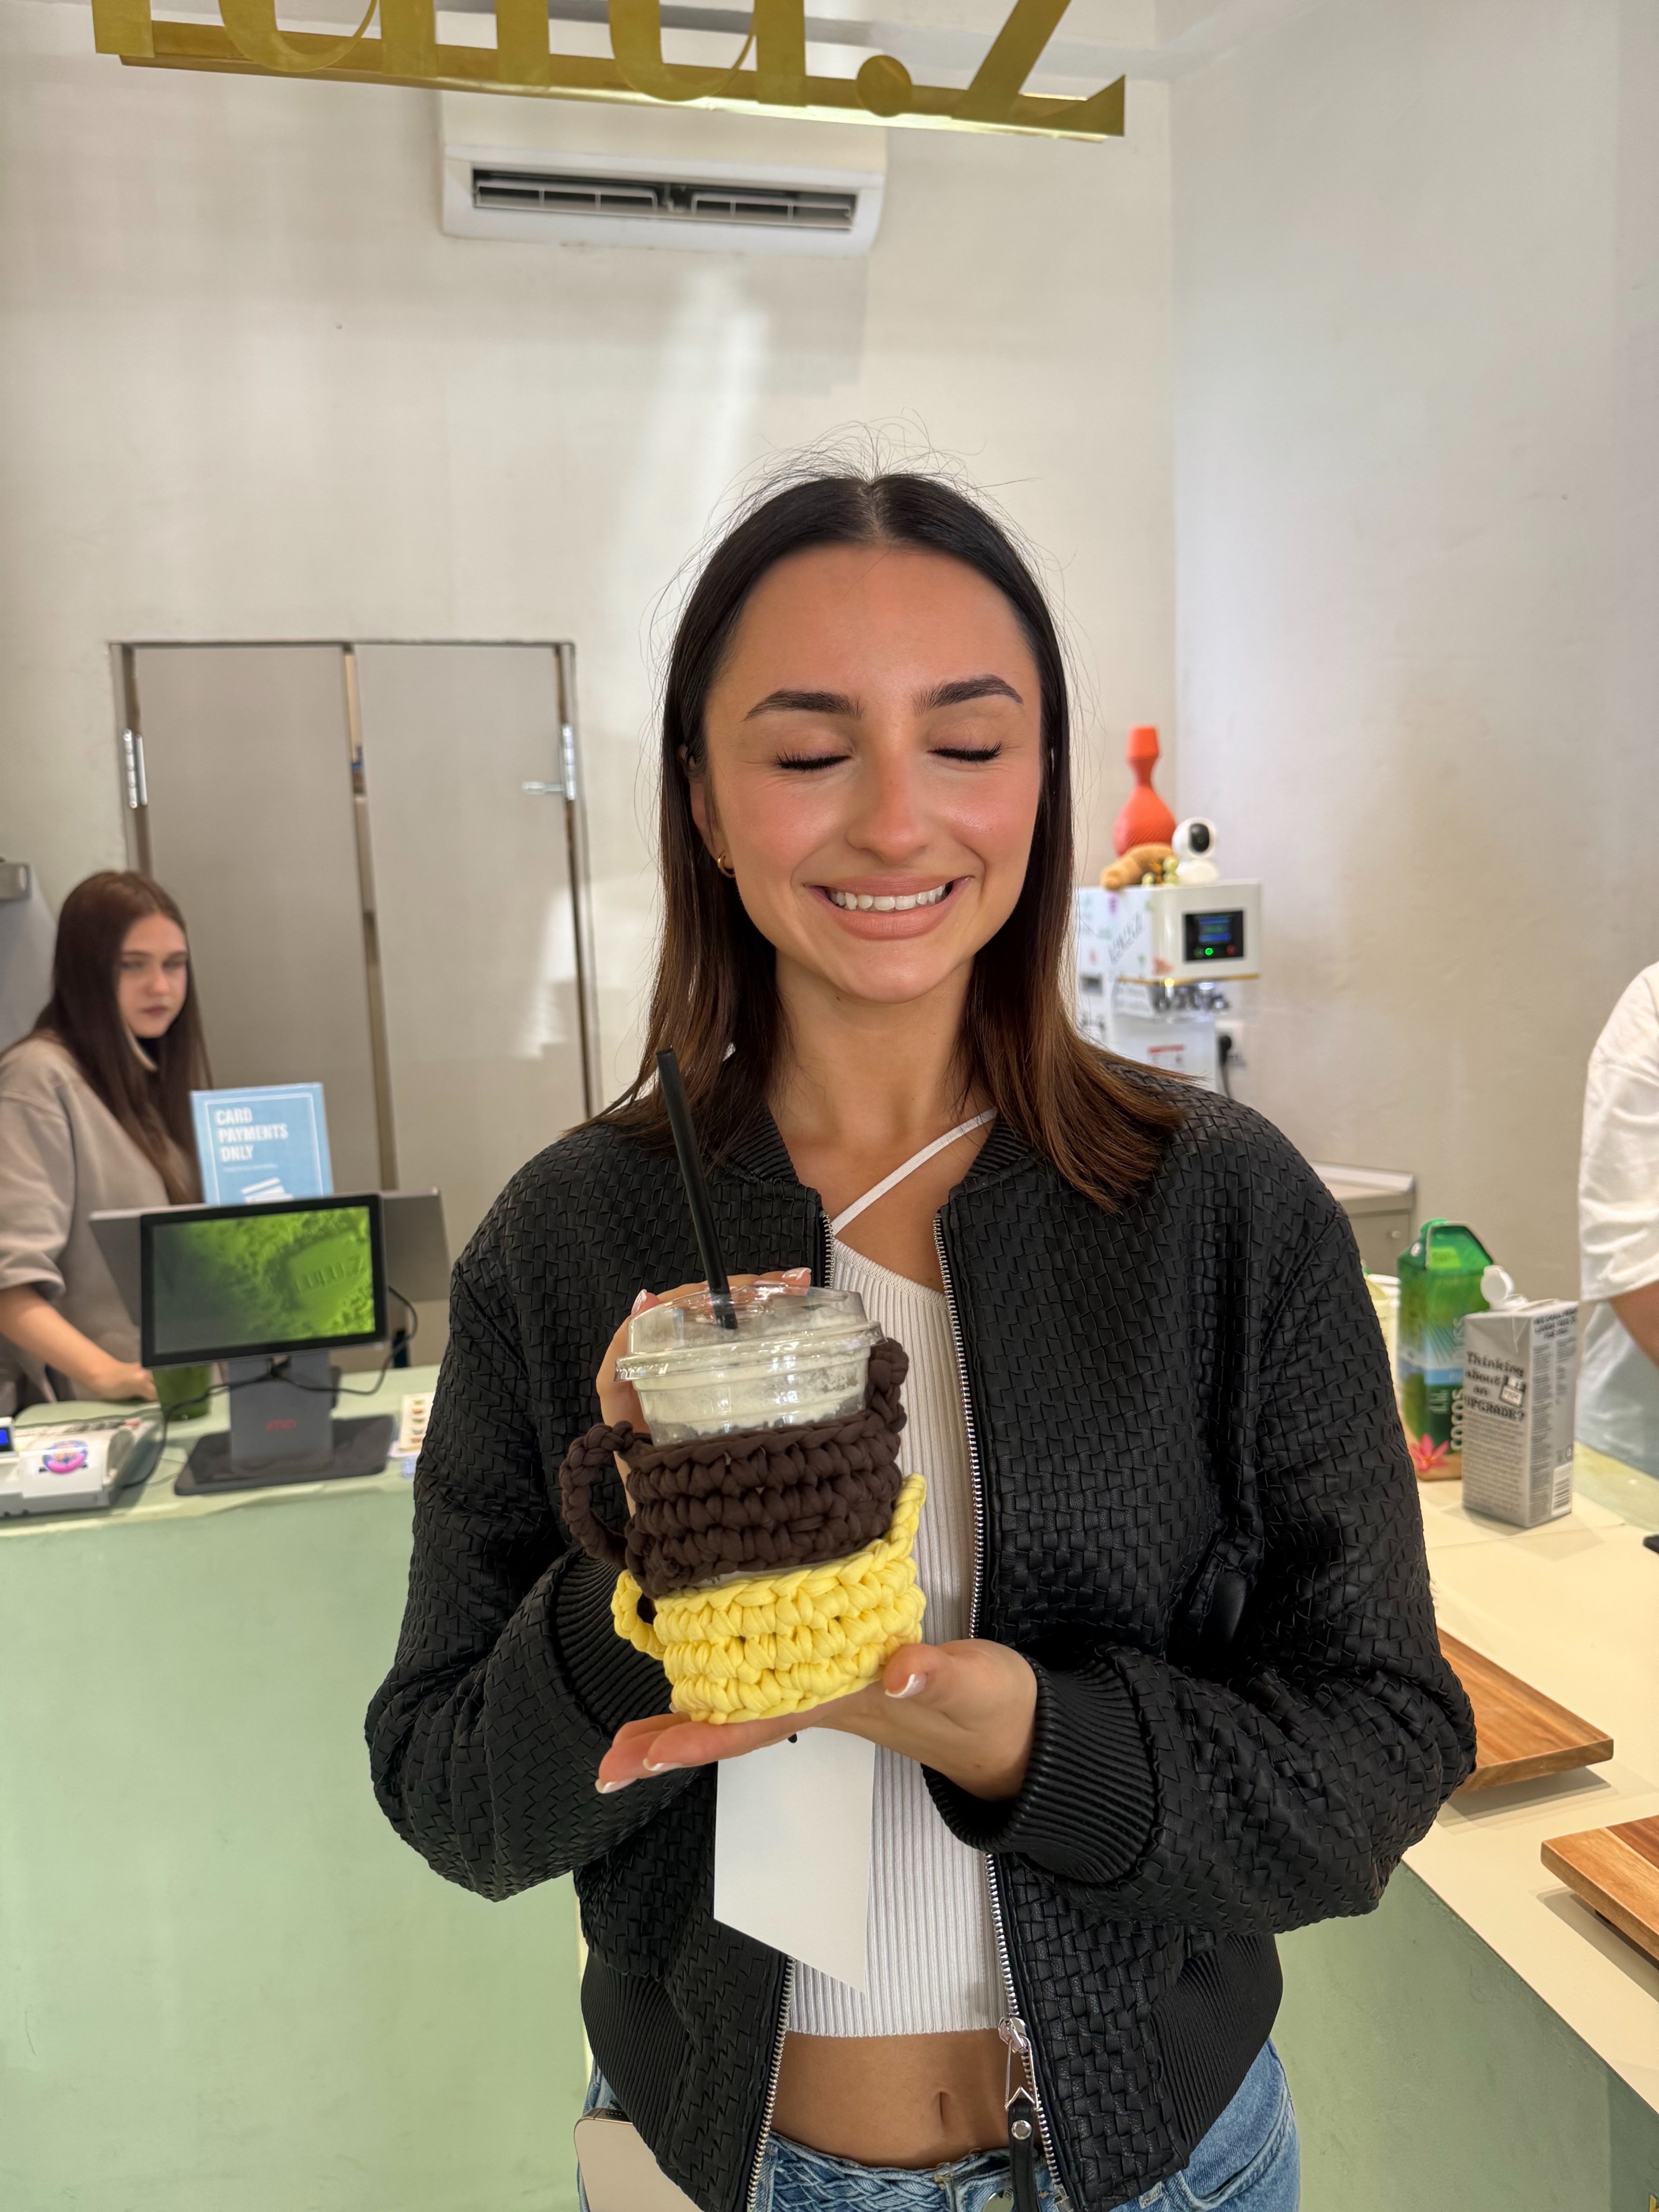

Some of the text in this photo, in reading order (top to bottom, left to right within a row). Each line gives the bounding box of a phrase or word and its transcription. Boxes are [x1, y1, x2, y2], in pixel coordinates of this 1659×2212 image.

[216, 1108, 252, 1125] CARD
[219, 1123, 288, 1142] PAYMENTS
[221, 1145, 253, 1162] ONLY
[1467, 1351, 1524, 1378] Thinking
[1465, 1367, 1501, 1386] about
[1473, 1385, 1488, 1396] an
[1464, 1395, 1525, 1422] UPGRADE?
